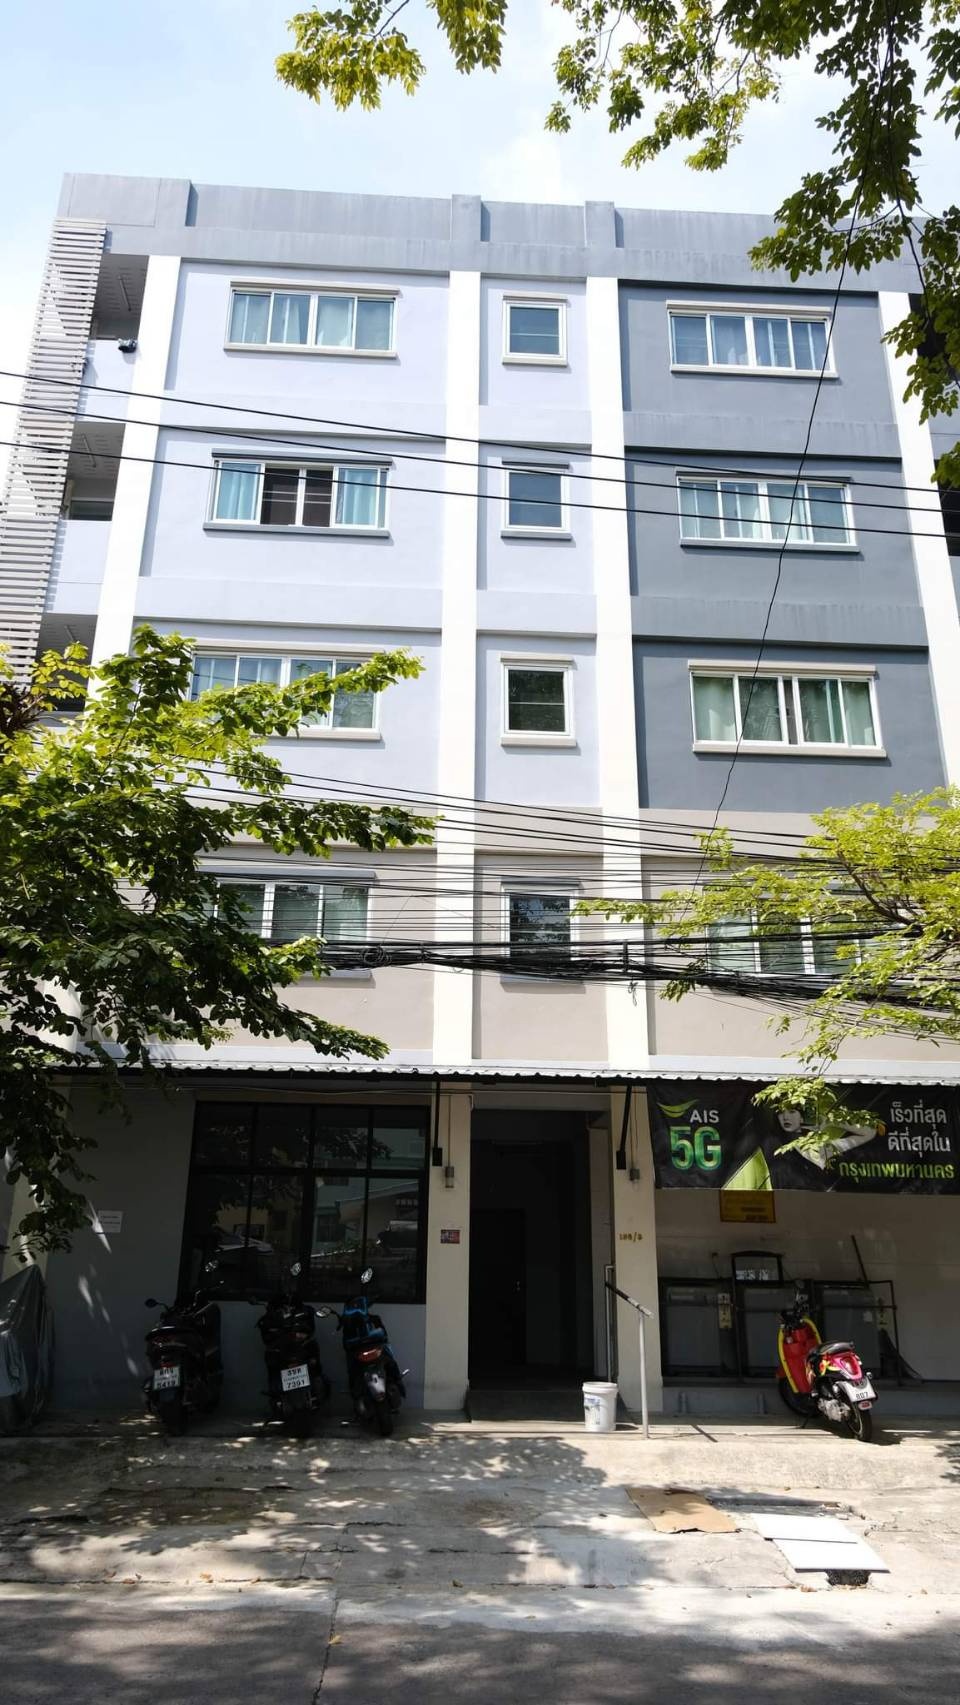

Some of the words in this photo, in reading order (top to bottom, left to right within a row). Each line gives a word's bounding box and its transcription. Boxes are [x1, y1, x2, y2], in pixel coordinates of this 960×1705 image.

[690, 1109, 719, 1123] AIS
[890, 1100, 947, 1130] เร็วที่สุด
[670, 1126, 721, 1170] 5G
[888, 1126, 951, 1158] ดีที่สุดใน
[839, 1162, 955, 1183] กรุงเทพมหานคร
